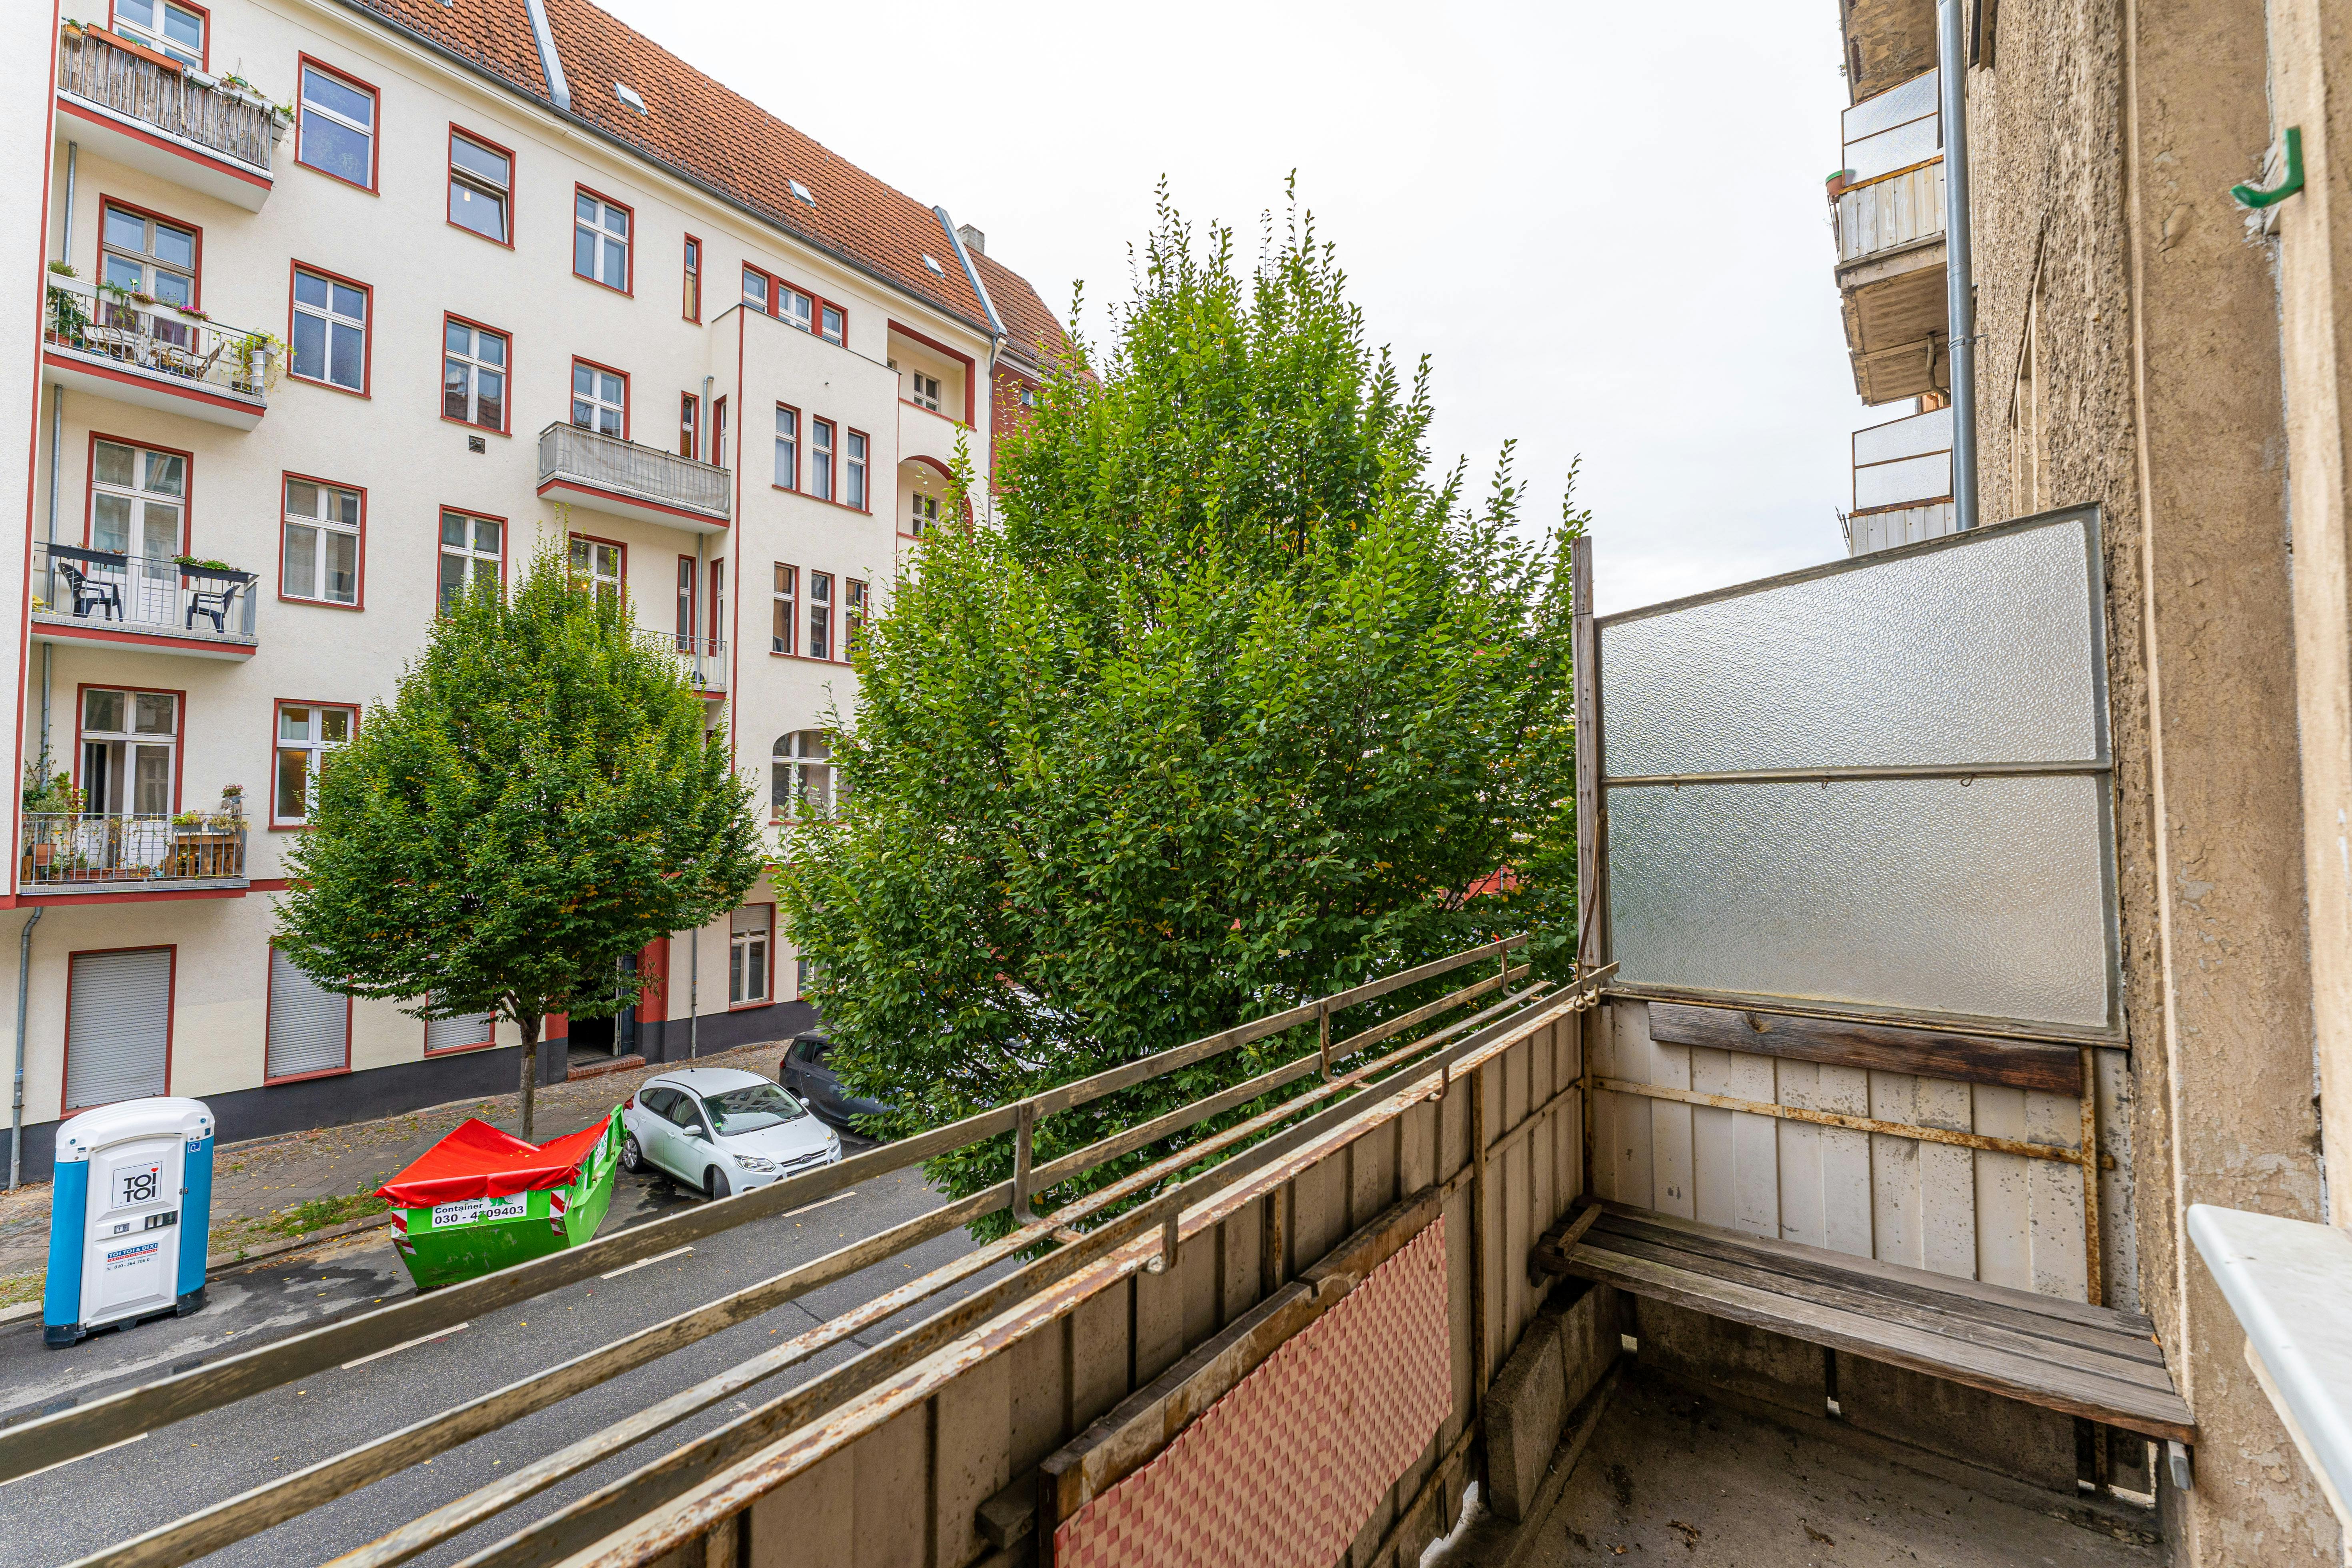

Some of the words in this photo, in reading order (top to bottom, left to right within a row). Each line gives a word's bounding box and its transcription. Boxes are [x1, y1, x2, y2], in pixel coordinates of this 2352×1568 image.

[124, 1172, 157, 1190] TOI
[123, 1185, 156, 1202] TOI
[435, 1203, 483, 1214] Container
[435, 1214, 458, 1224] 030
